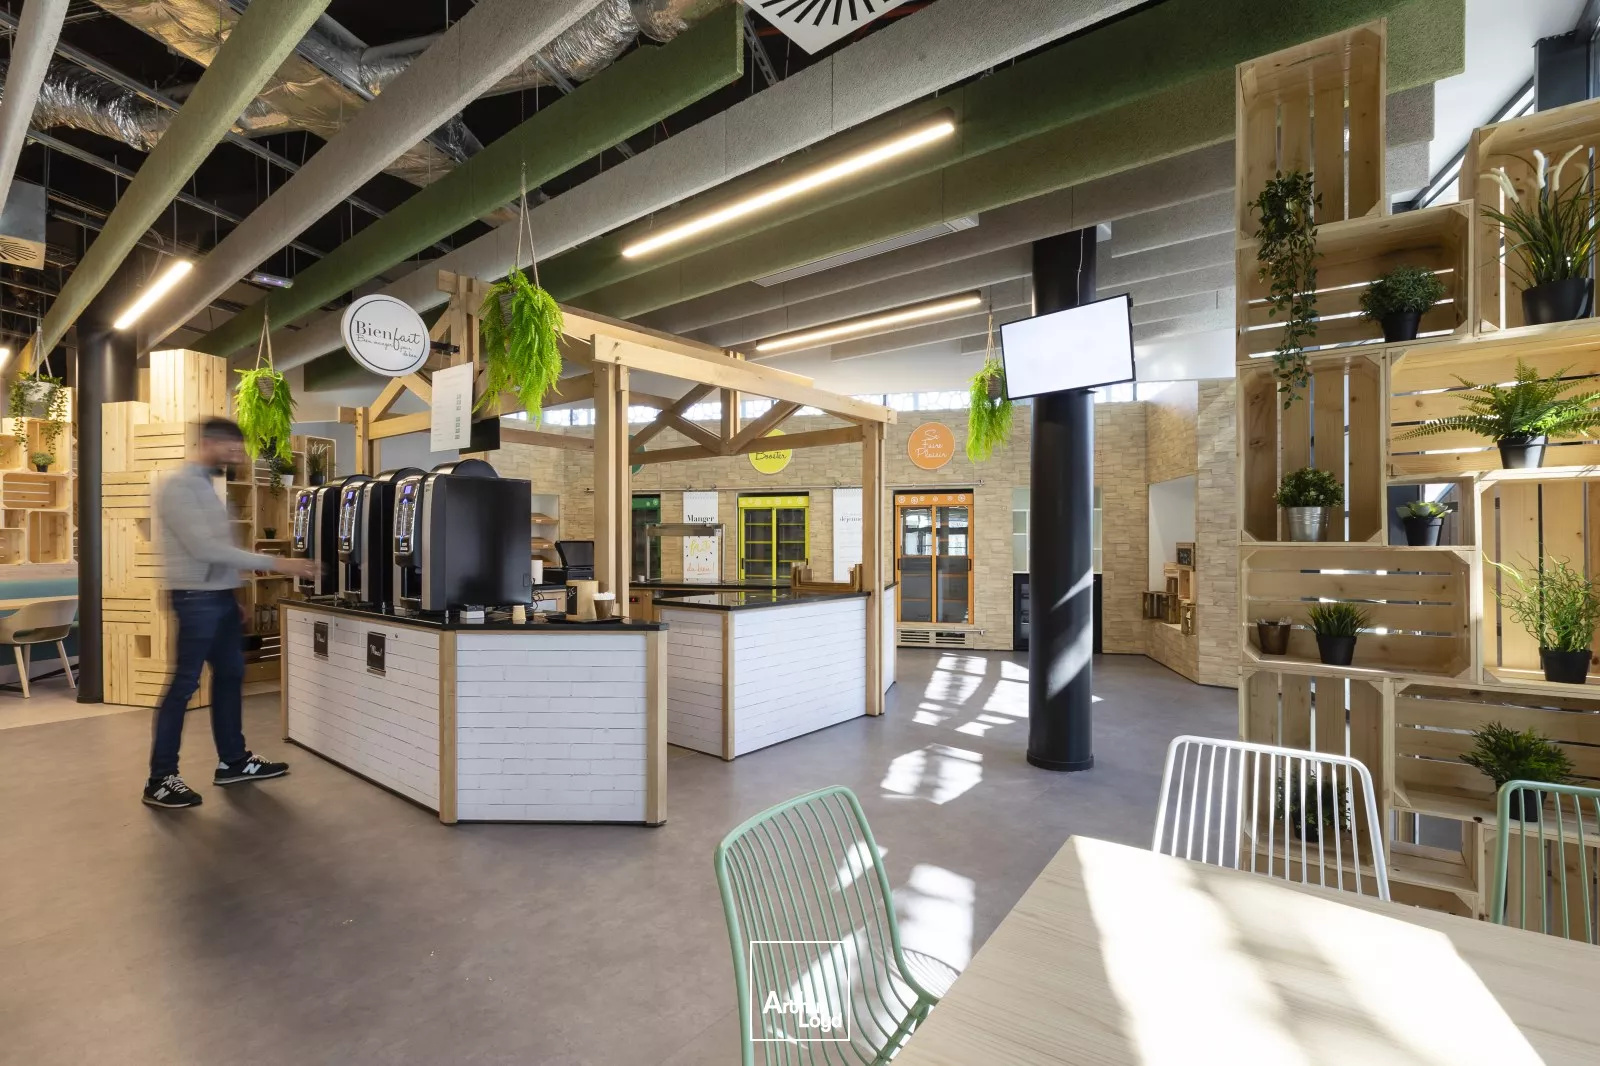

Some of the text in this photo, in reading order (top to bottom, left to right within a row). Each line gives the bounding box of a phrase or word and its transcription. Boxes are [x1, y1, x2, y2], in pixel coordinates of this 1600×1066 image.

[355, 319, 421, 351] Bienfait
[687, 514, 714, 523] Manger
[242, 763, 261, 774] N
[153, 787, 170, 800] N
